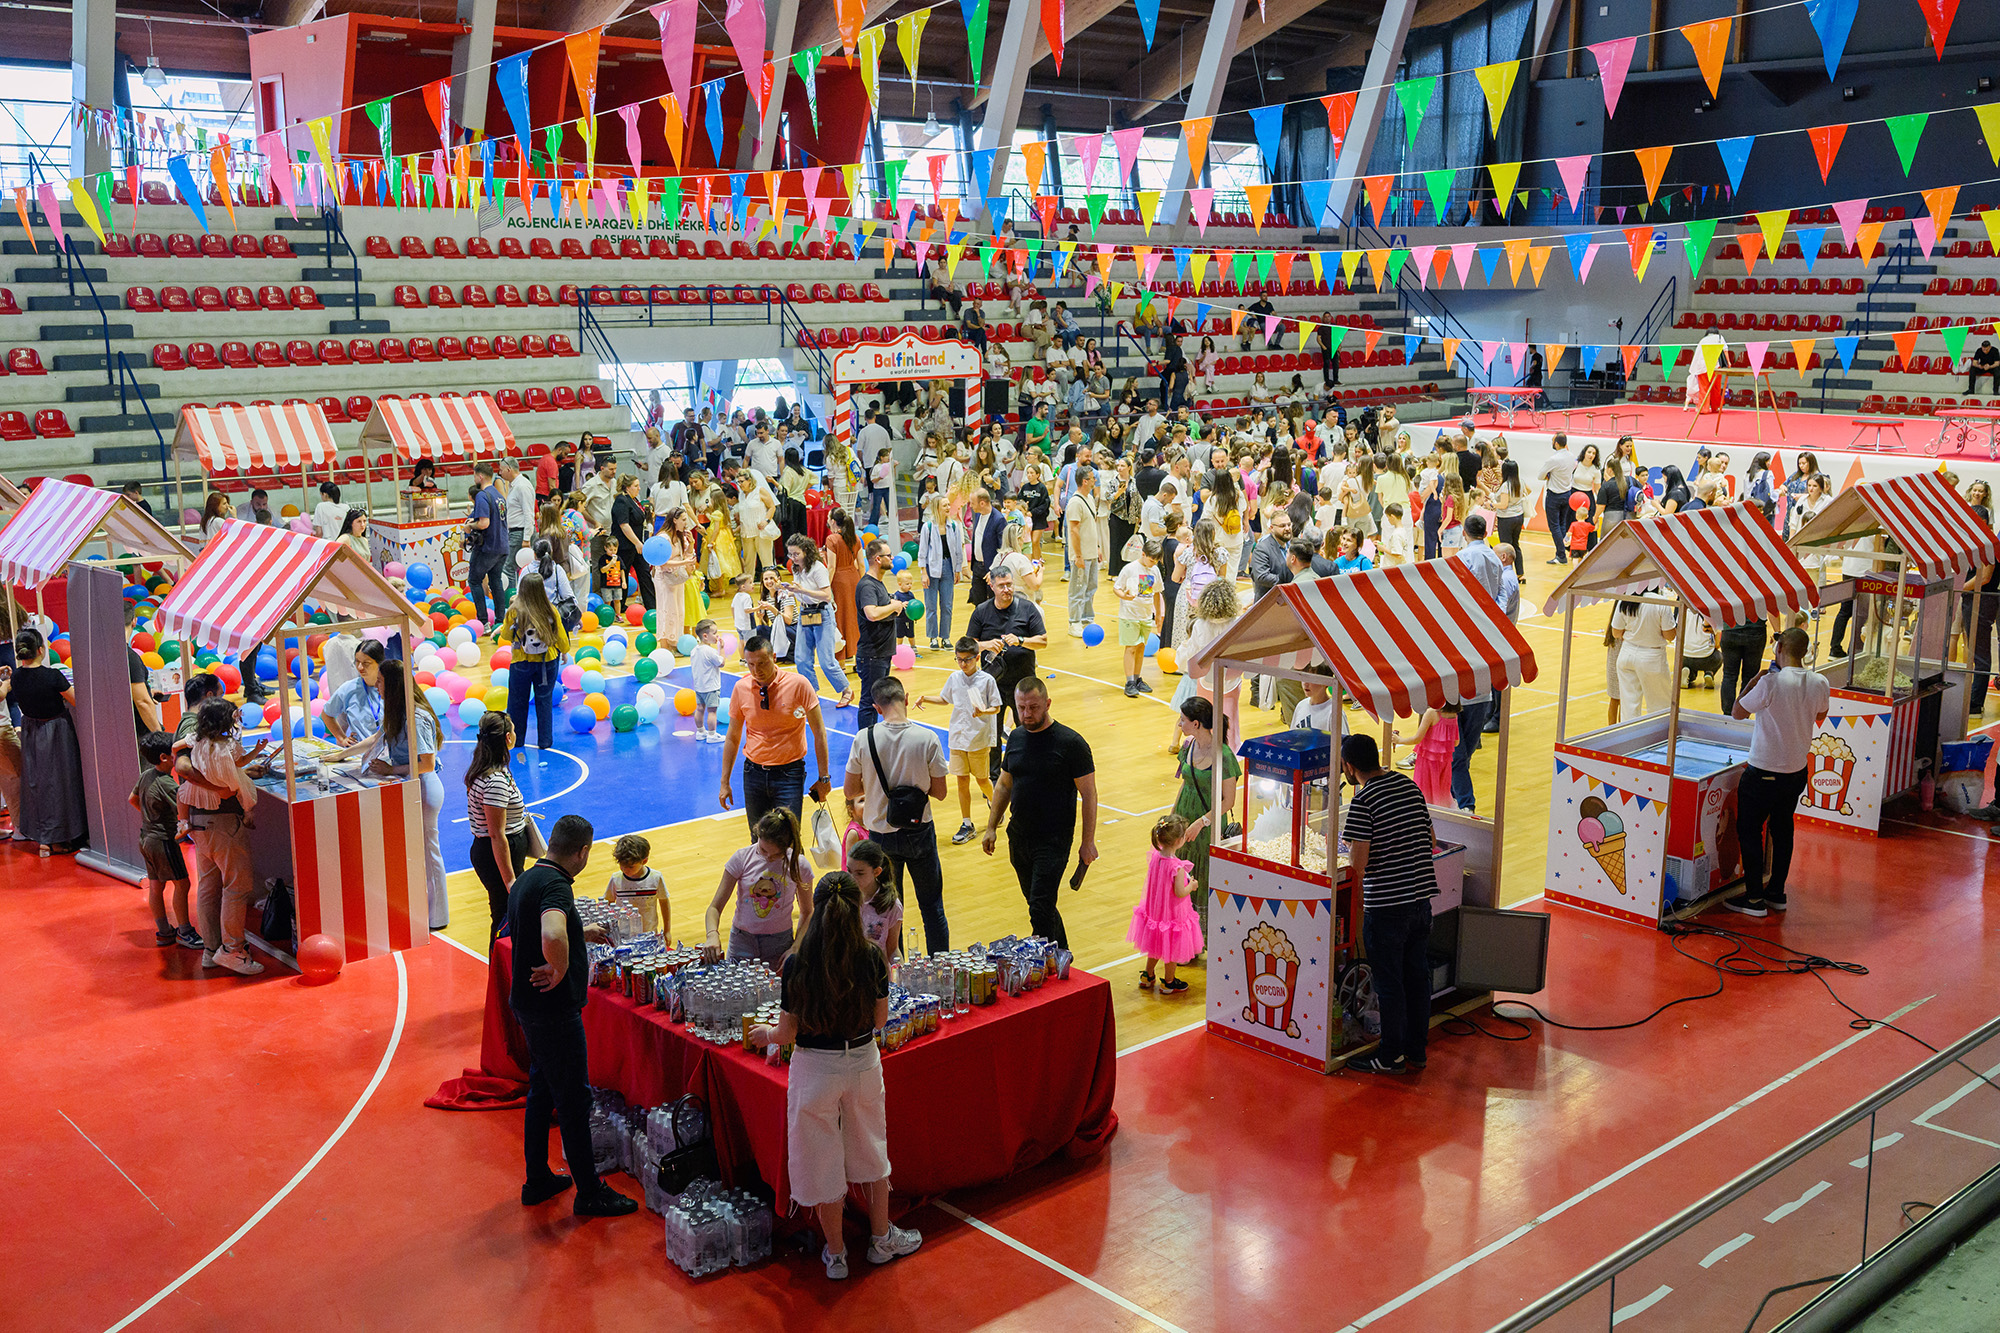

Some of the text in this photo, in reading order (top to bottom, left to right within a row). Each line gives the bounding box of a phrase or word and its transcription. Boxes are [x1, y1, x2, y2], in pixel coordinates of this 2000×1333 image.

[507, 217, 572, 228] AGJENCIA
[575, 219, 582, 229] E
[1392, 234, 1405, 250] A
[1652, 232, 1666, 249] C
[874, 350, 945, 368] BalfinLand
[1862, 581, 1914, 596] POP CON
[1813, 778, 1842, 787] POPCORN
[1255, 984, 1286, 997] POPCORN
